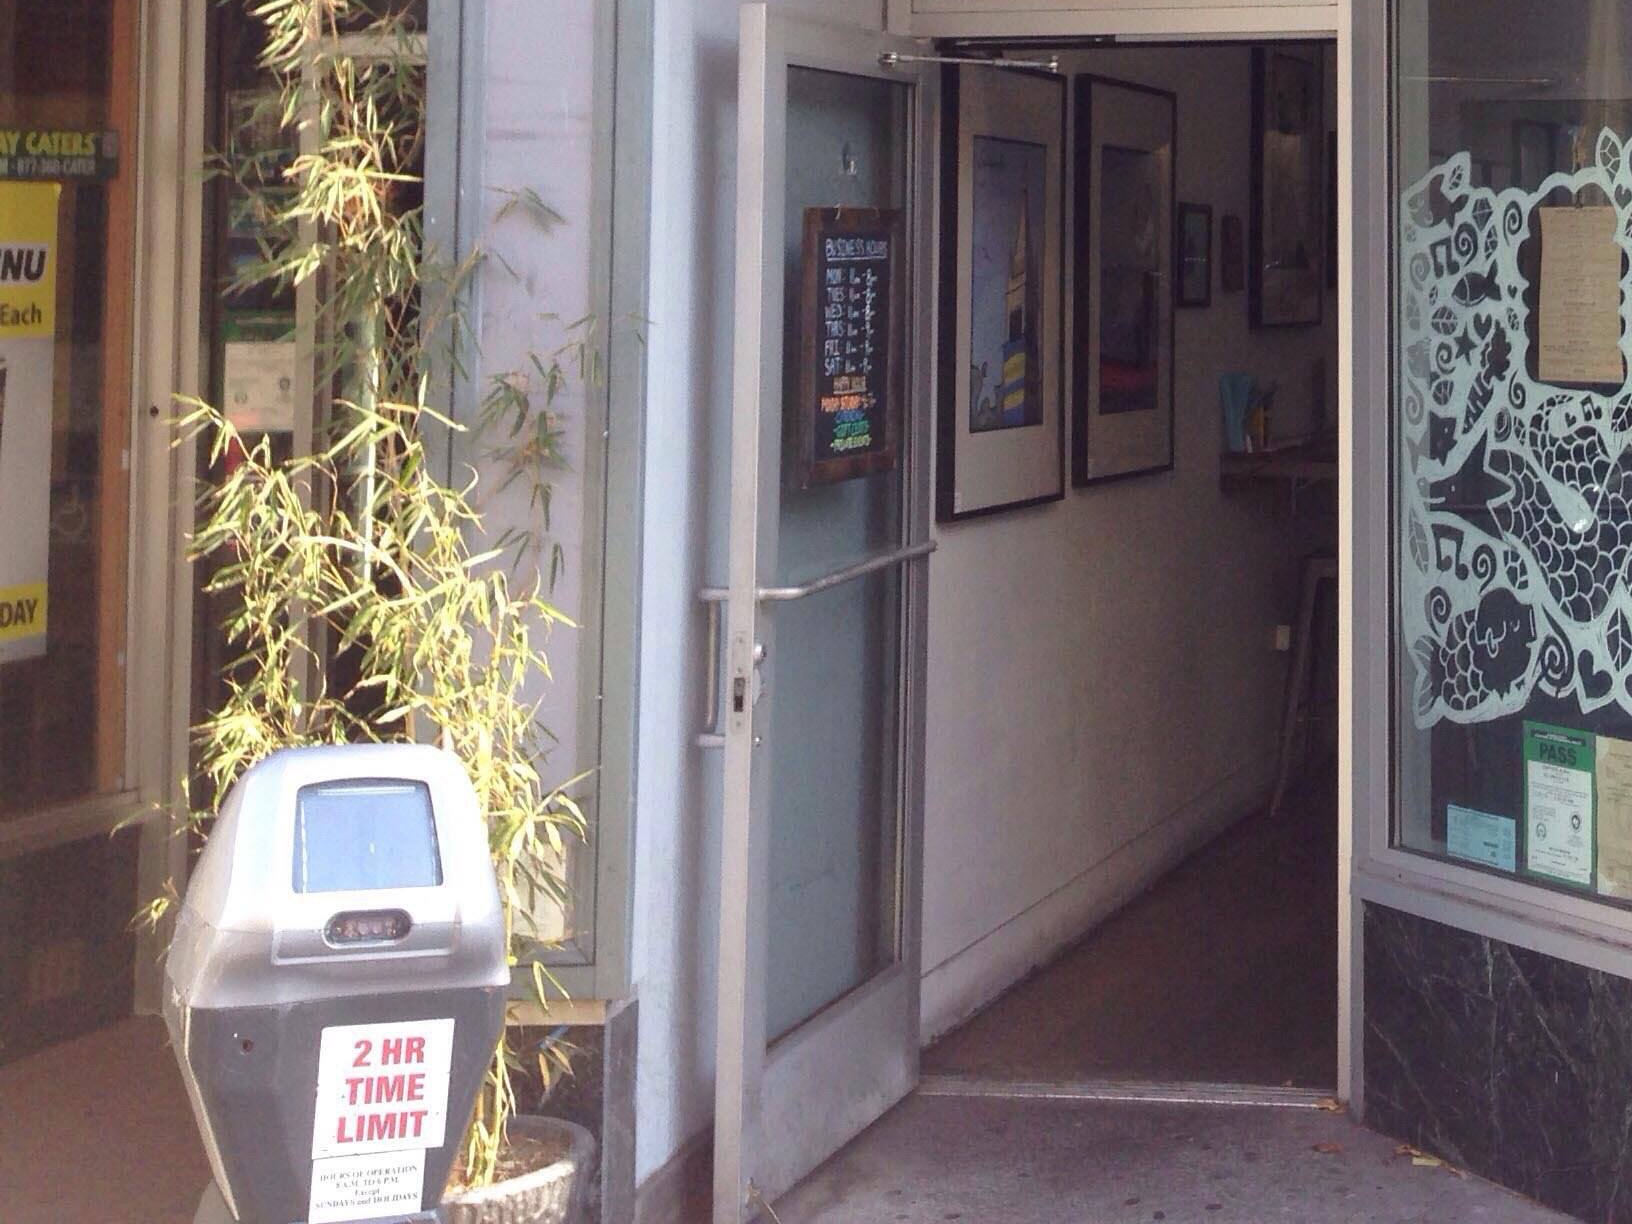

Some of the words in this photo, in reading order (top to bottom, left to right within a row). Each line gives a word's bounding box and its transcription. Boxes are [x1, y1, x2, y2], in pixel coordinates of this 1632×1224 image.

[25, 131, 97, 156] CATERS
[0, 248, 47, 281] NU
[0, 302, 42, 326] Each
[1540, 742, 1577, 766] PASS
[352, 1039, 373, 1068] 2
[381, 1036, 426, 1066] HR
[345, 1073, 426, 1106] TIME
[336, 1109, 429, 1144] LIMIT
[366, 1164, 418, 1177] OPERATION
[372, 1191, 419, 1204] HOLIDAYS
